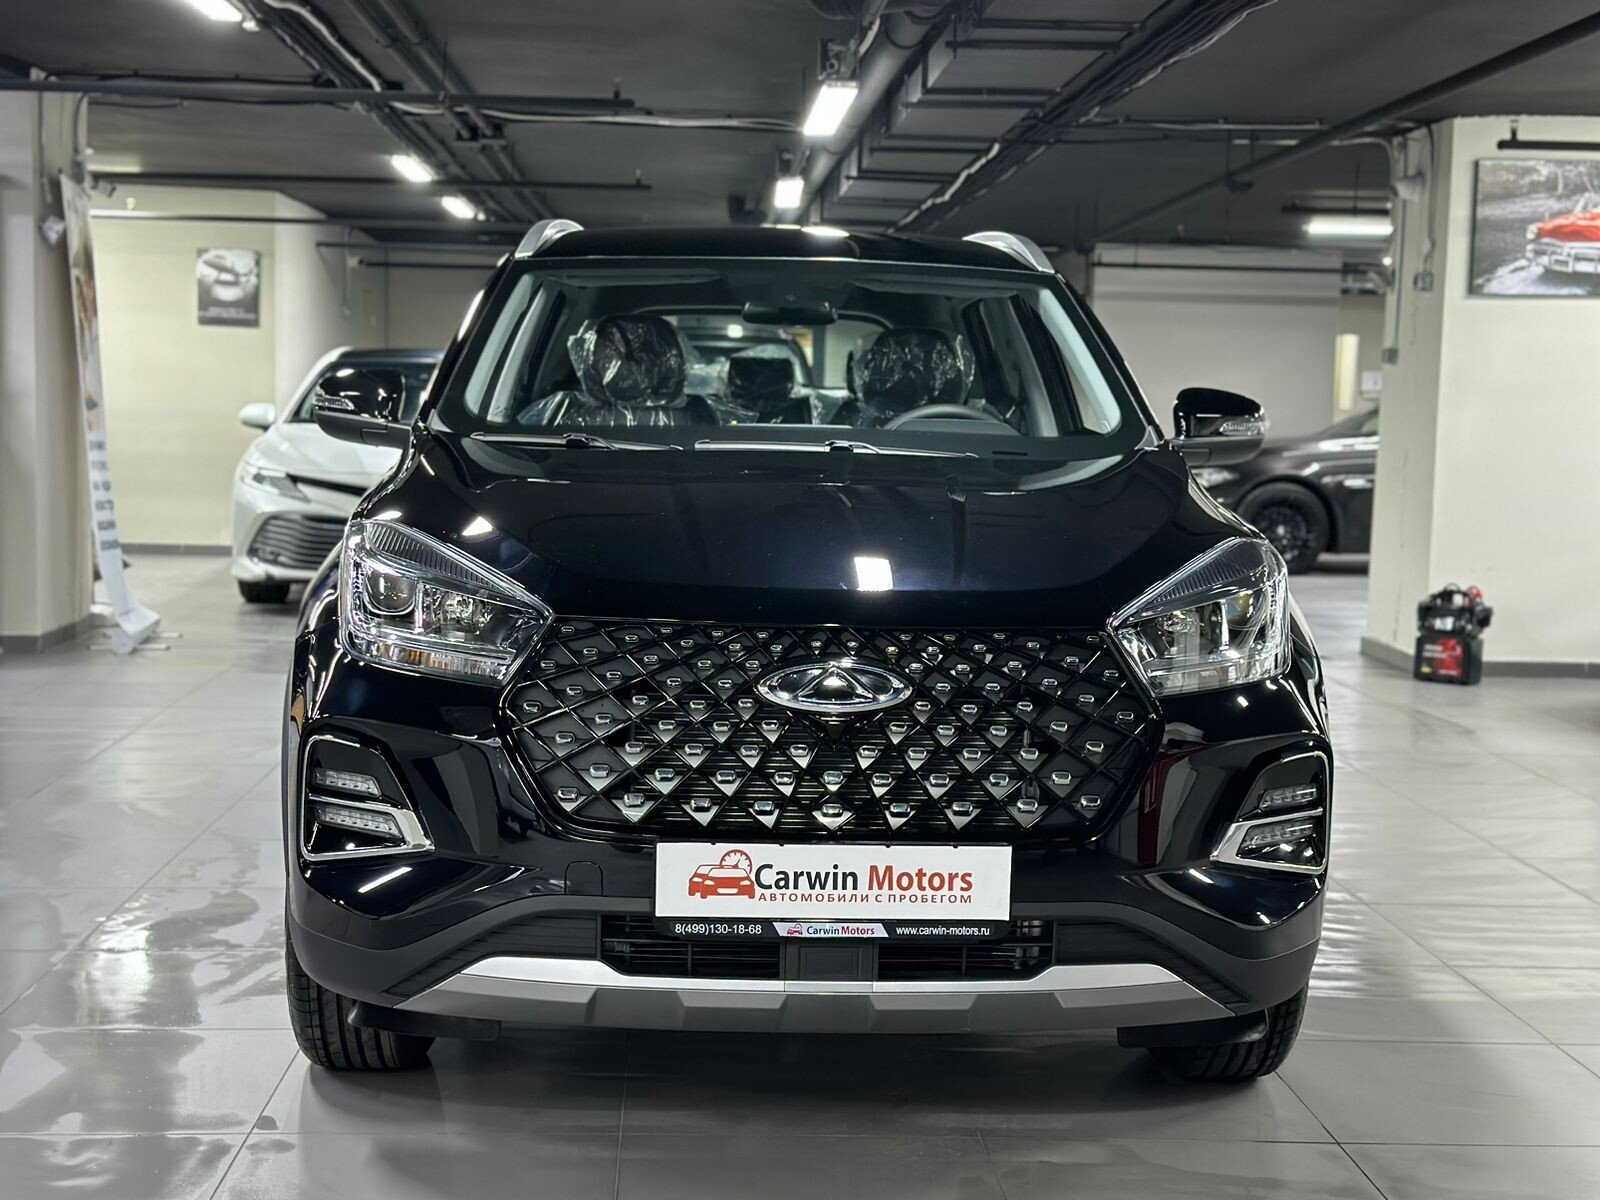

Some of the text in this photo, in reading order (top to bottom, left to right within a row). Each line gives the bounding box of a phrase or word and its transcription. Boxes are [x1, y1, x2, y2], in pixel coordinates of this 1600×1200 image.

[755, 863, 973, 891] Carwin Motors
[758, 893, 869, 903] АВТОМОБИЛИ
[888, 893, 972, 904] ПРОБЕГОМ
[675, 924, 762, 935] 8(499)130-18-68
[806, 925, 875, 936] Carwin Motors
[896, 926, 990, 936] www.carwin-motors.ru
